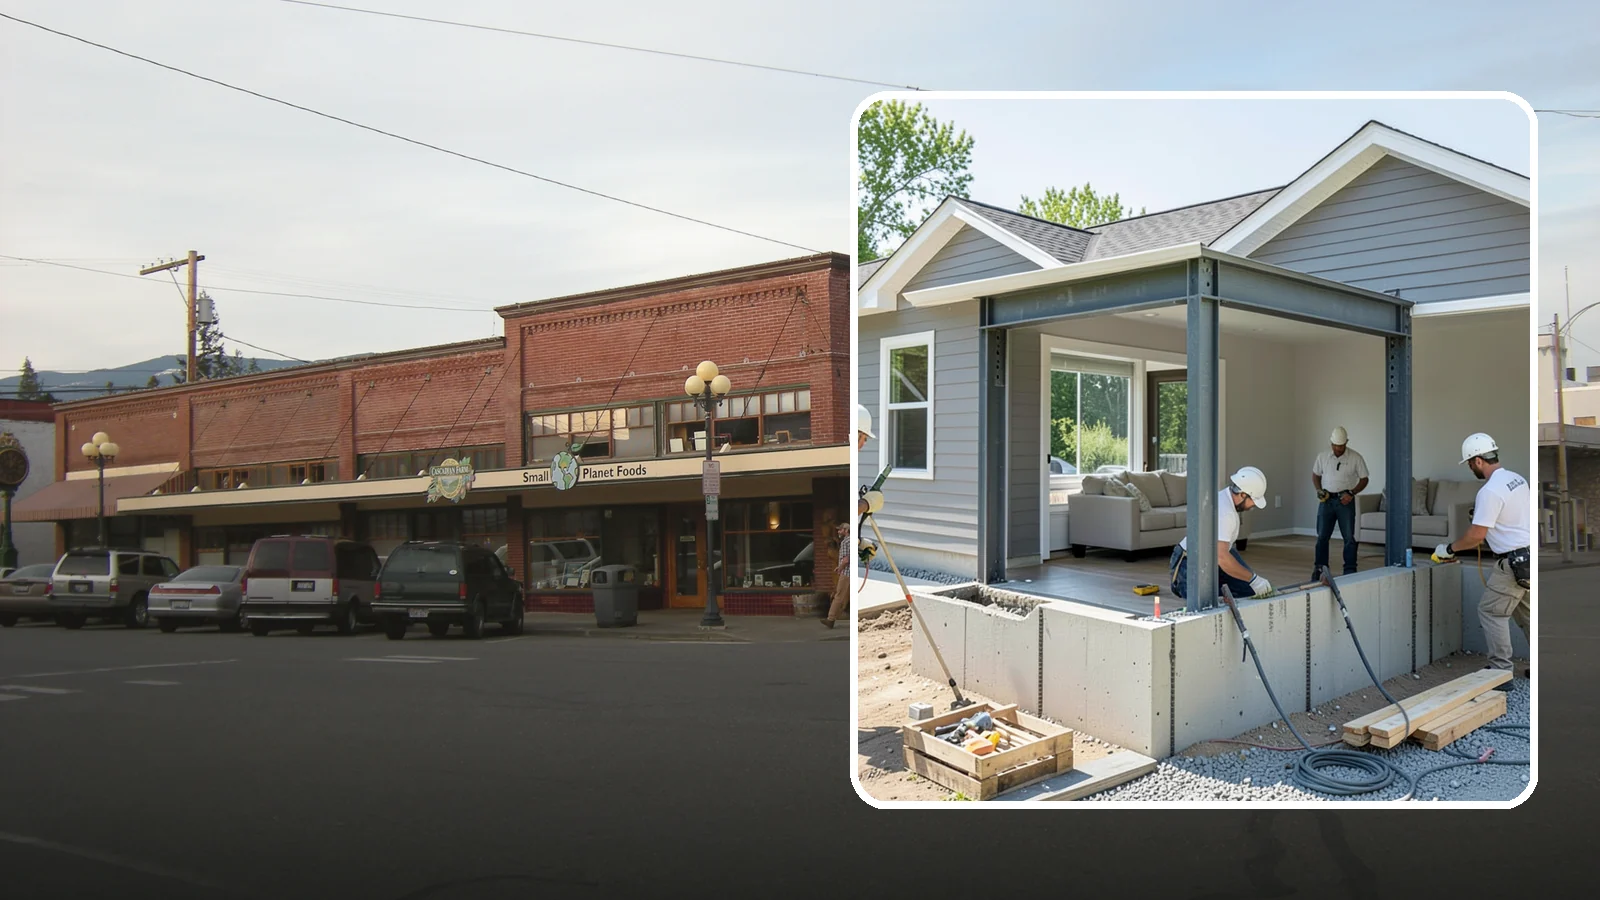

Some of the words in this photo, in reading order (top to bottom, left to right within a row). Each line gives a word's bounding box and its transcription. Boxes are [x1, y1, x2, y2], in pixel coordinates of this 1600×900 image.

[523, 471, 549, 483] Small
[582, 468, 614, 479] Planet
[616, 464, 647, 477] Foods
